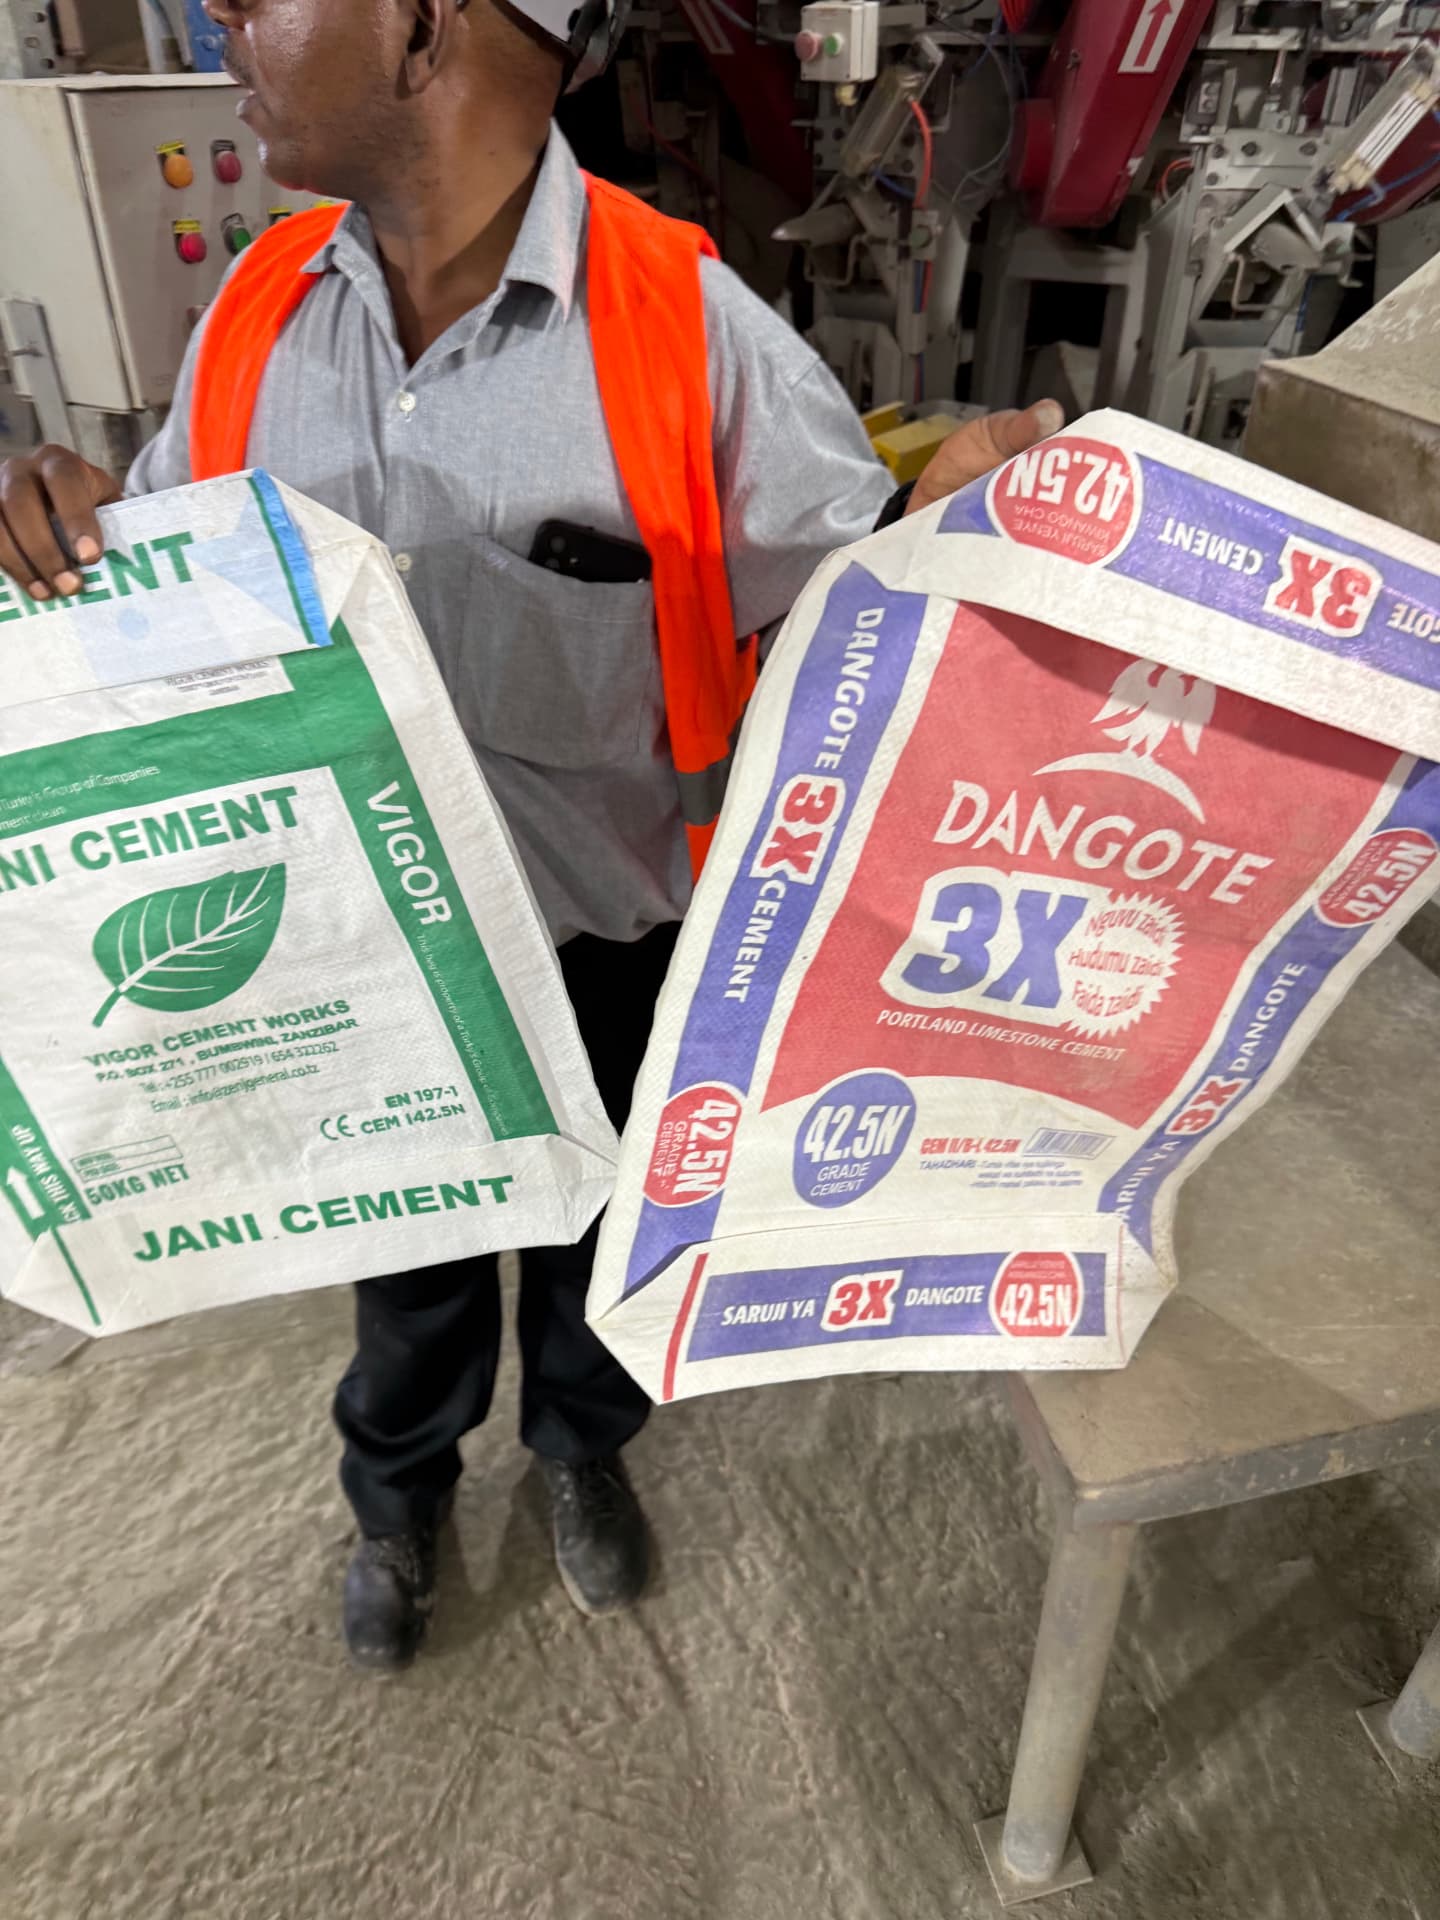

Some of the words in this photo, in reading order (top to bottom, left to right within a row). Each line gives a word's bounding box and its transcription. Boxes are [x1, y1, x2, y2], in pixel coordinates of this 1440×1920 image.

[1006, 448, 1130, 522] 42.5N
[1156, 517, 1263, 576] CEMENT
[1275, 550, 1373, 630] 3X
[813, 607, 886, 770] DANGOTE
[97, 765, 160, 785] Companies
[70, 785, 299, 871] CEMENT
[367, 780, 452, 925] VIGOR
[761, 781, 838, 874] 3X
[932, 779, 1275, 905] DANGOTE
[1343, 840, 1438, 919] 42.5N
[724, 878, 787, 1003] CEMENT
[900, 881, 1089, 1010] 3X
[84, 1044, 158, 1066] VIGOR
[163, 1018, 257, 1052] CEMENT
[262, 1000, 351, 1030] WORKS
[280, 1018, 360, 1042] ZANZIBAR
[876, 1009, 967, 1035] PORTLAND
[967, 1022, 1062, 1050] LIMESTONE
[1060, 1041, 1126, 1061] CEMENT
[1146, 1139, 1181, 1163] YA
[1228, 962, 1307, 1072] DANGOTE
[360, 1115, 401, 1134] CEM
[384, 1092, 412, 1109] EN
[413, 1085, 459, 1103] 197-1
[12, 1124, 36, 1146] UP
[24, 1146, 51, 1176] WAY
[652, 1121, 674, 1177] CEMENT
[663, 1120, 688, 1177] GRADE
[671, 1099, 739, 1196] 42.5N
[803, 1104, 912, 1163] 42.5N
[40, 1174, 71, 1205] THIS
[85, 1175, 147, 1206] 50KG
[148, 1163, 190, 1189] NET
[809, 1179, 865, 1197] CEMENT
[817, 1161, 872, 1181] GRADE
[132, 1213, 263, 1262] JANI
[279, 1176, 514, 1234] CEMENT
[721, 1301, 787, 1326] SARUJI
[790, 1299, 817, 1319] YA
[828, 1278, 896, 1326] 3X
[904, 1285, 985, 1307] DANGOTE
[1000, 1283, 1073, 1327] 42.5N
